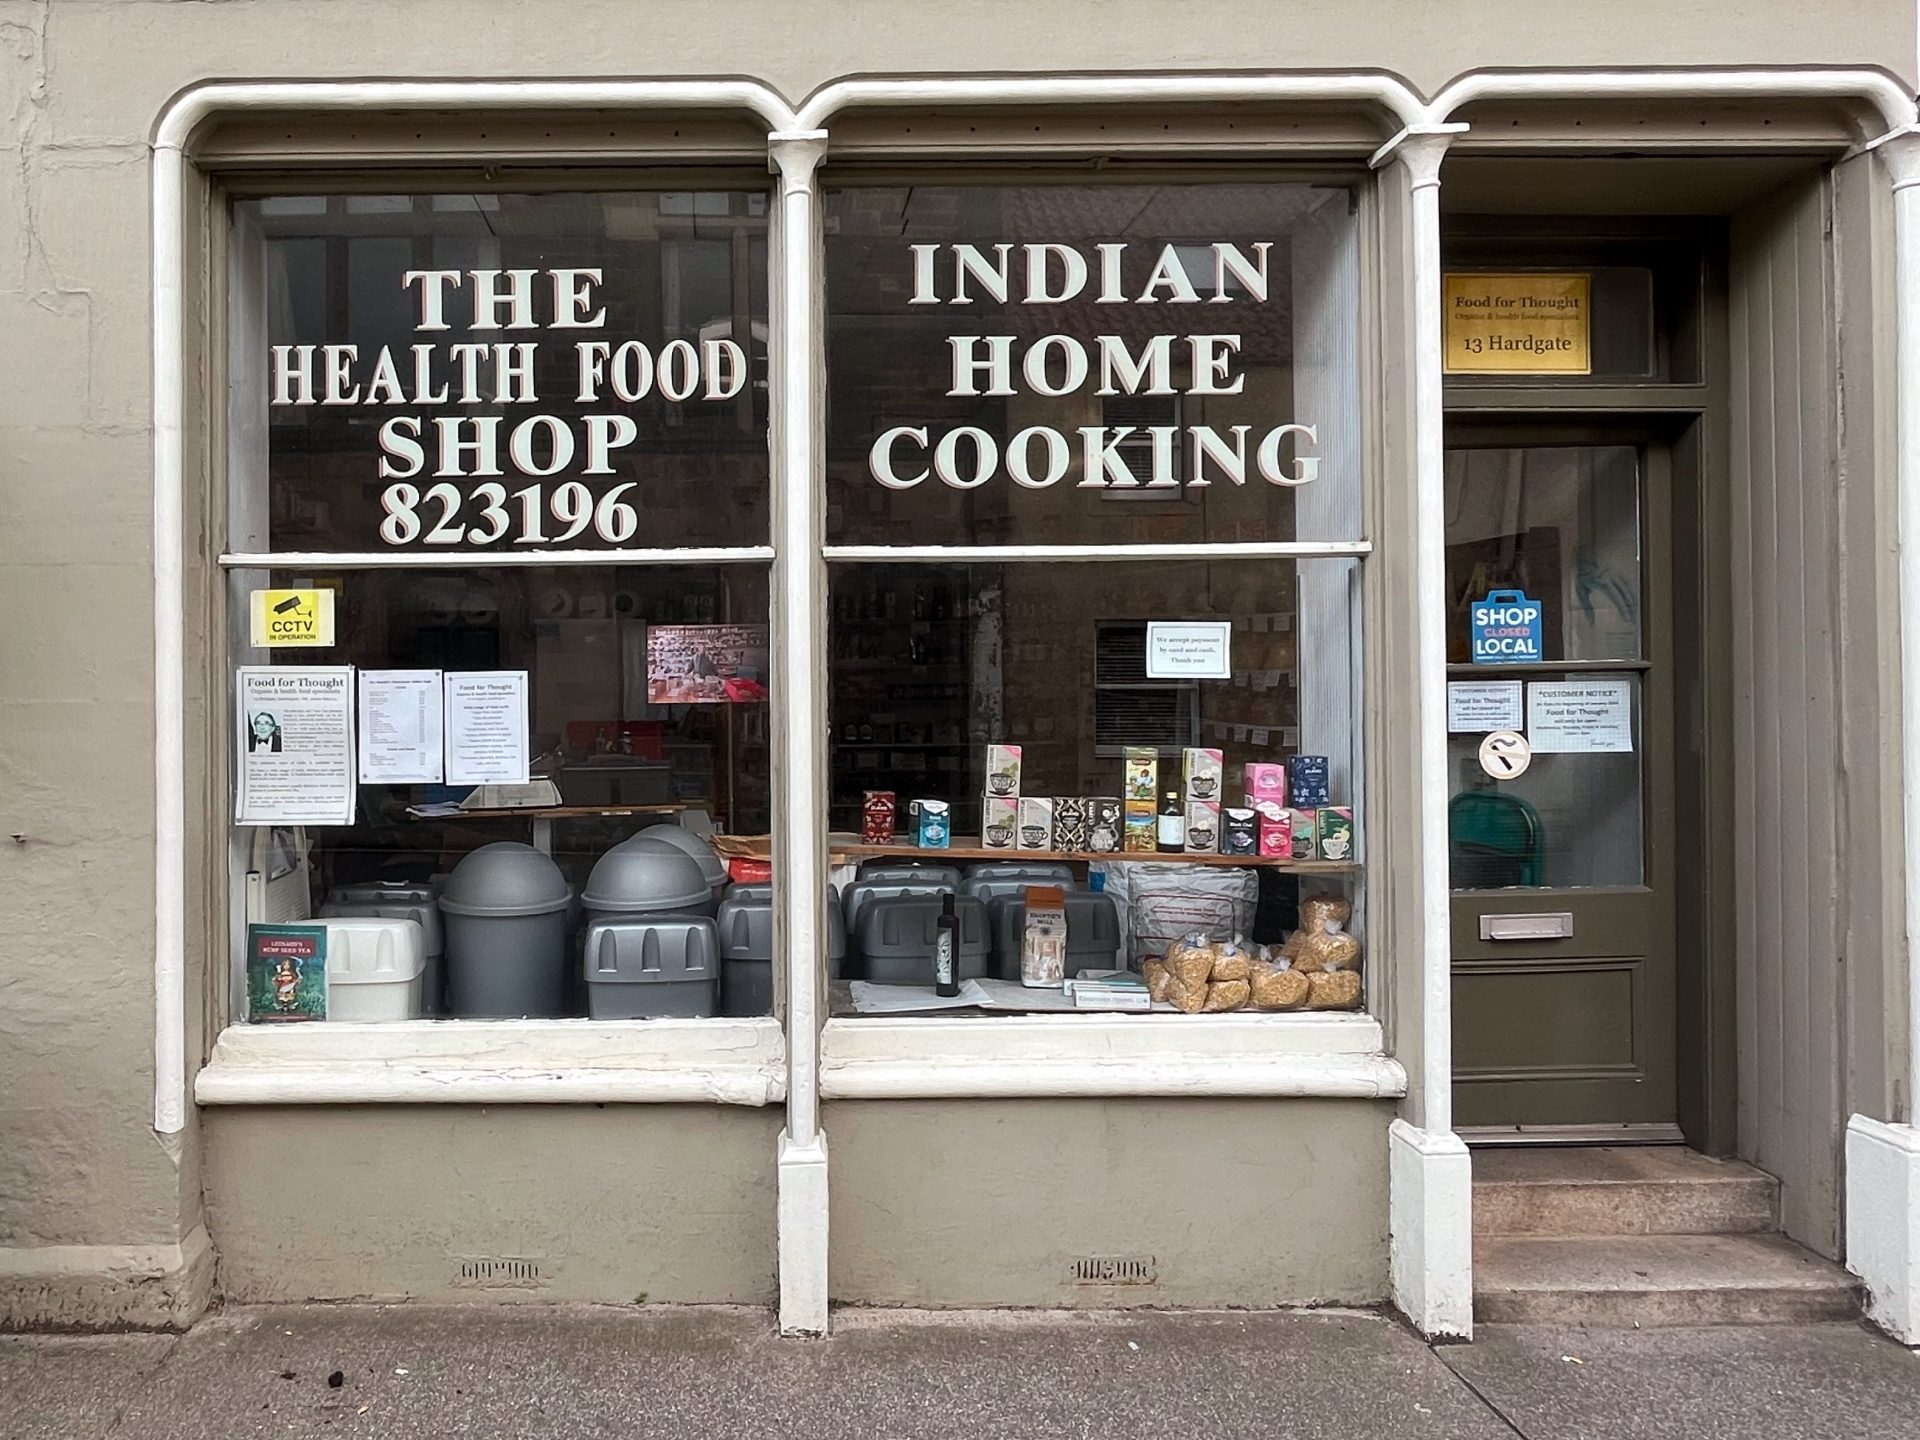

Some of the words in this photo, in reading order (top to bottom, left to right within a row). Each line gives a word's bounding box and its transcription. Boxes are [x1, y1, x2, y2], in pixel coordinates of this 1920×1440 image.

[908, 242, 1275, 305] INDIAN
[402, 267, 607, 332] THE
[1455, 296, 1491, 309] Food
[1495, 296, 1517, 309] for
[1519, 296, 1580, 311] Thought
[1464, 338, 1483, 354] 13
[1488, 334, 1572, 355] Hardgate
[270, 342, 540, 407] HEALTH
[574, 338, 748, 403] FOOD
[945, 333, 1246, 397] HOME
[378, 414, 638, 479] SHOP
[868, 423, 1322, 490] COOKING
[379, 481, 639, 545] 823196
[271, 620, 313, 633] CCTV
[1475, 607, 1538, 626] SHOP
[278, 633, 317, 641] OPERATION
[1483, 627, 1531, 637] CLOSED
[1476, 638, 1538, 655] LOCAL
[247, 677, 276, 688] Food
[278, 677, 295, 688] for
[297, 677, 345, 689] Thought
[1566, 708, 1578, 716] for
[1579, 708, 1610, 717] Thought
